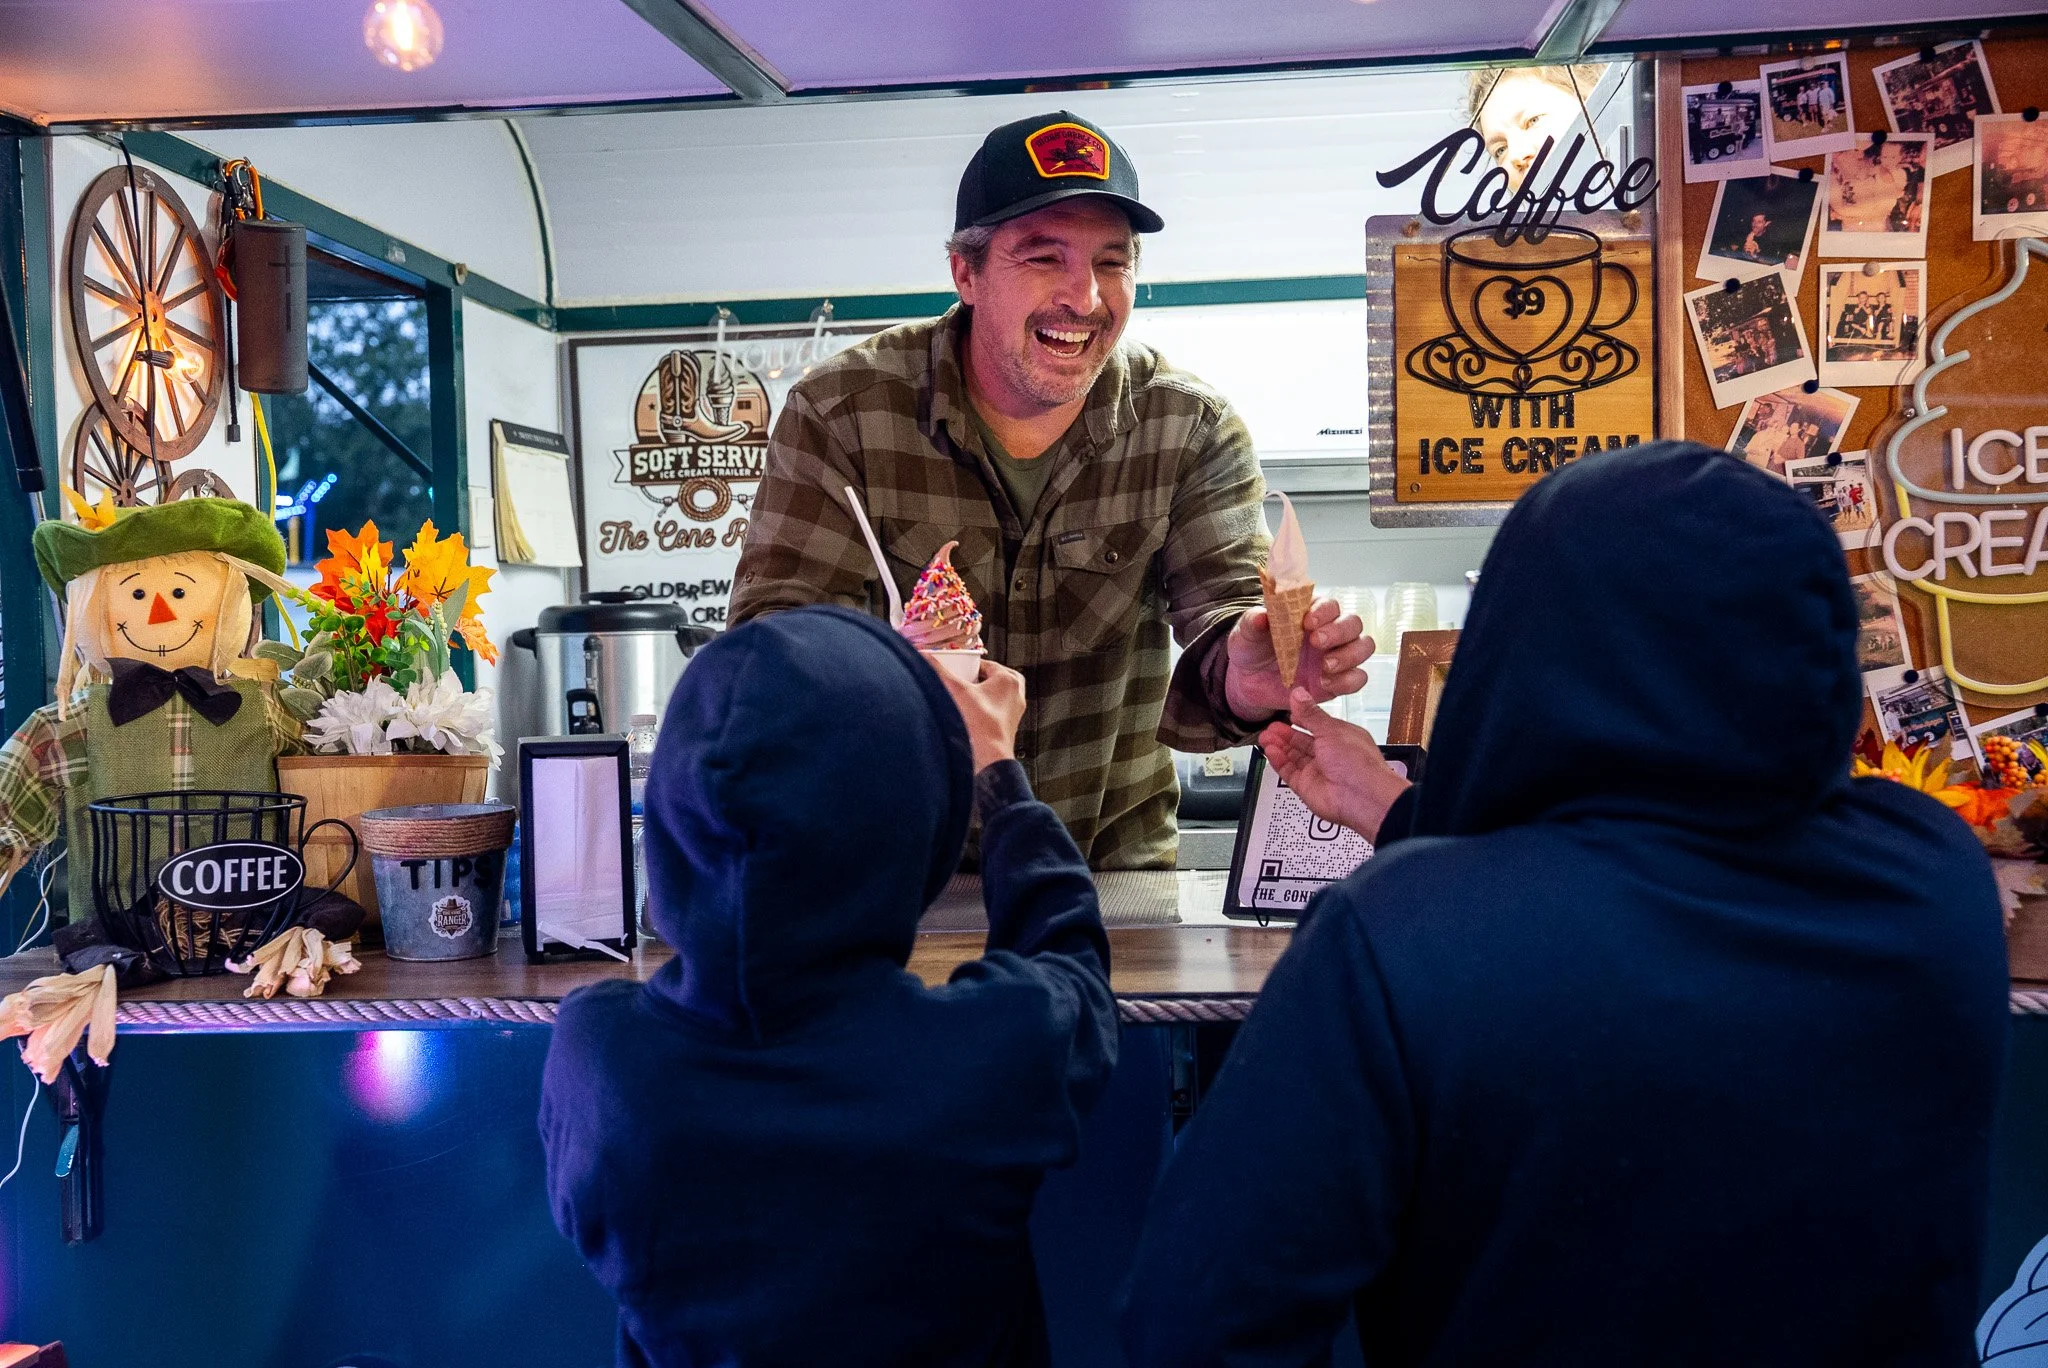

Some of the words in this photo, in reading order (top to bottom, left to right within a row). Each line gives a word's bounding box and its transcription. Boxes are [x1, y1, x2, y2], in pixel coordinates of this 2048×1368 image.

[1376, 127, 1661, 247] Coffee
[1502, 283, 1546, 319] $9
[1467, 393, 1576, 429] WITH
[634, 446, 693, 476] SOFT
[678, 469, 711, 478] CREAM
[713, 467, 752, 477] TRAILER
[1419, 437, 1484, 475] ICE
[600, 520, 649, 554] The
[654, 519, 717, 551] Cone
[172, 855, 288, 896] COFFEE
[400, 855, 494, 890] TIPS
[437, 913, 467, 928] RANGER
